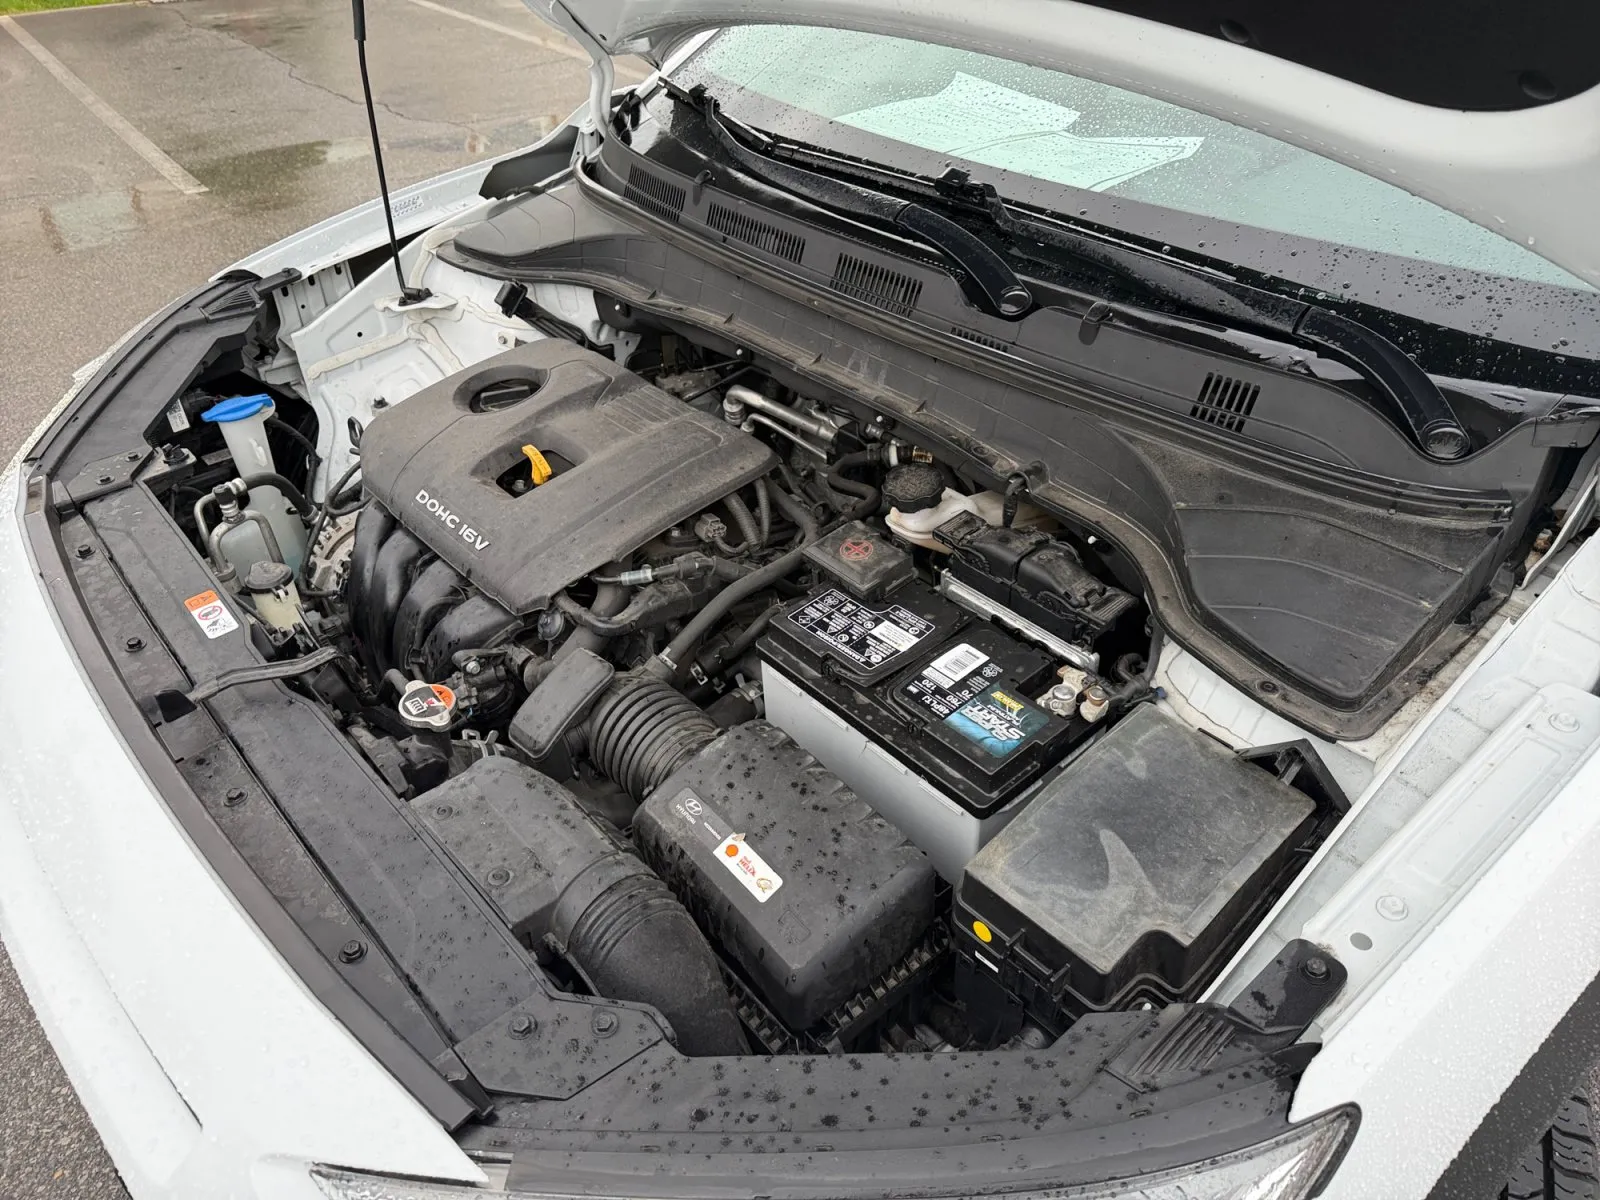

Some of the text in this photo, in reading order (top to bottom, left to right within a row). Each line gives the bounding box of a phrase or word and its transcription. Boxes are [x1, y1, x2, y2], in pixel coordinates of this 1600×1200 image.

[415, 489, 490, 551] DOHC 16V
[921, 679, 937, 691] 120
[961, 689, 974, 699] 70
[921, 695, 950, 715] 48PLTJ
[946, 695, 963, 708] 760
[960, 707, 1008, 741] SUPER
[972, 705, 1026, 740] START
[675, 803, 697, 824] HYUNDAI
